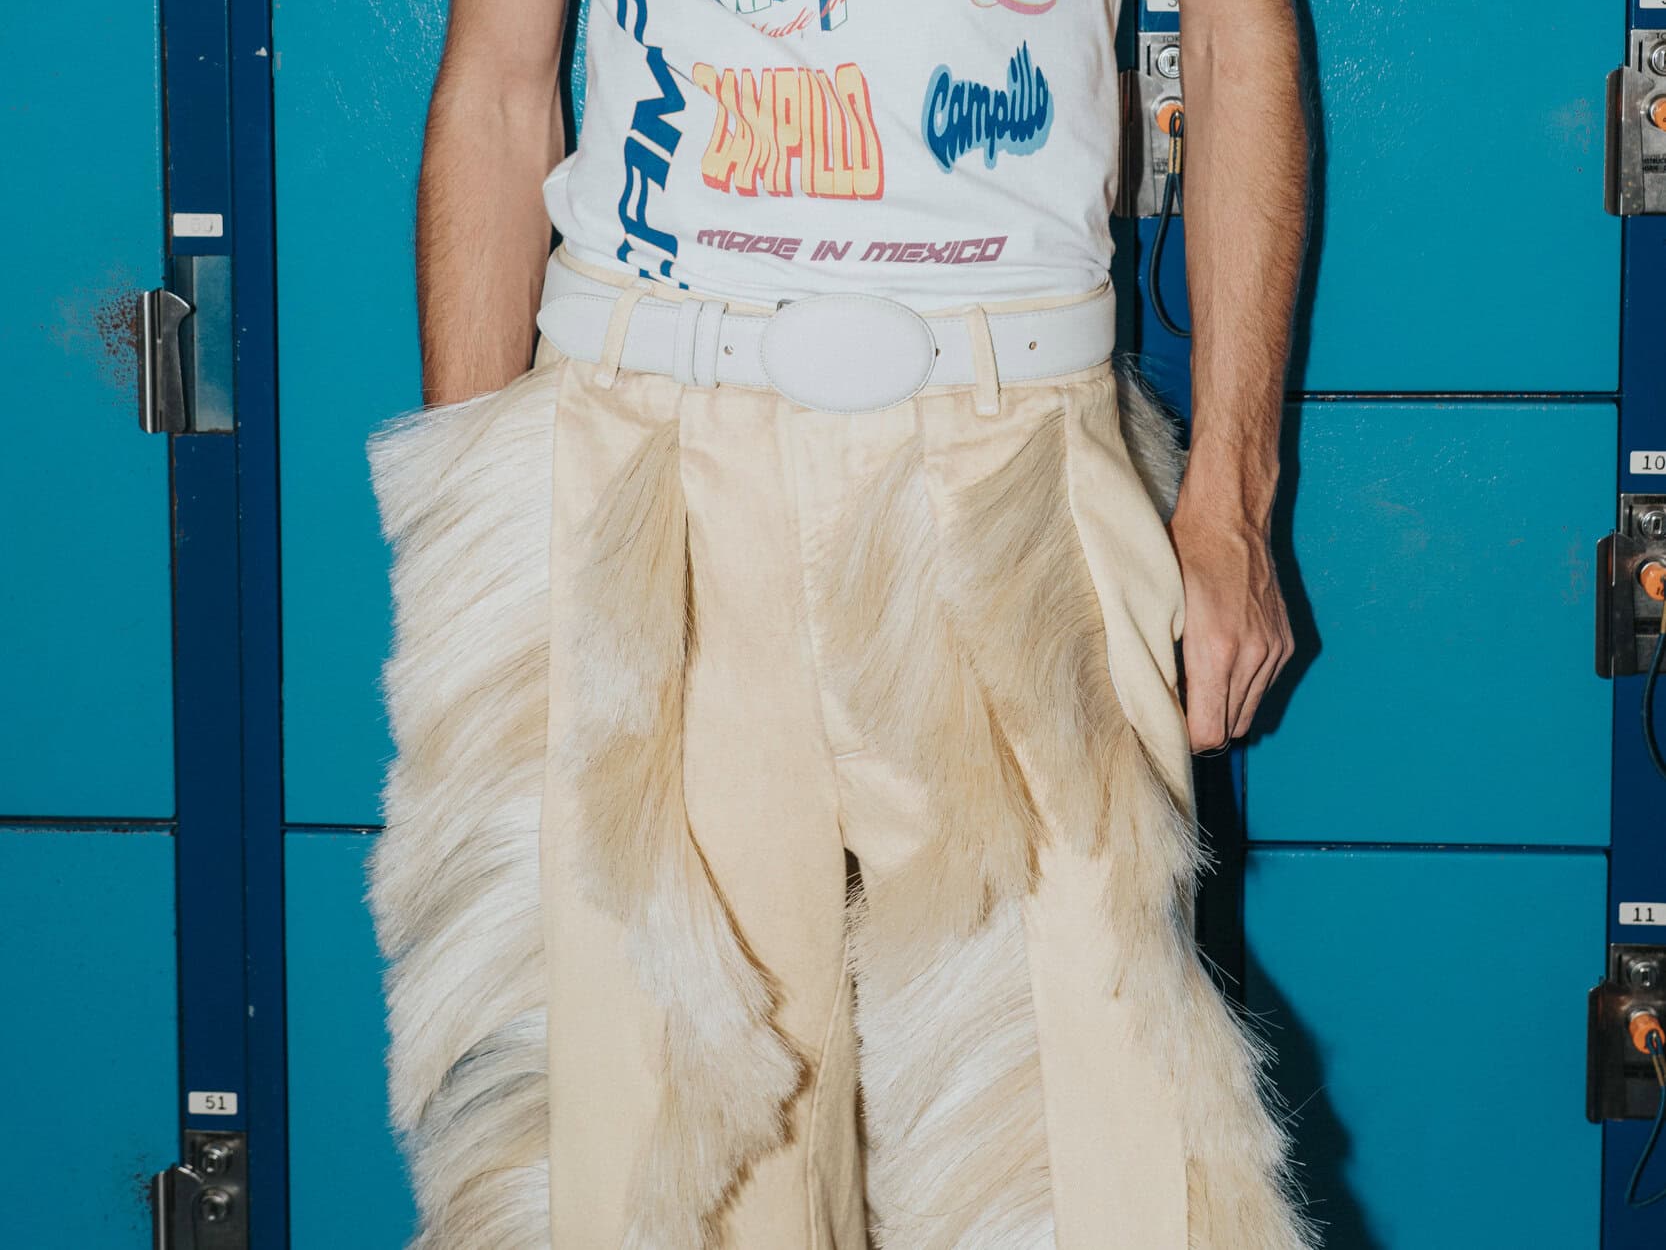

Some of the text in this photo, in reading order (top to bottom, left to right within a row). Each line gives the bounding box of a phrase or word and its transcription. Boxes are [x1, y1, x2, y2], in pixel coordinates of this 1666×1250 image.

[927, 41, 1049, 168] Campillo
[692, 62, 885, 201] CAMPILLO
[697, 229, 1008, 265] MADE IN MEXICO
[1641, 454, 1666, 471] 10
[1632, 907, 1655, 923] 11
[205, 1095, 227, 1110] 51
